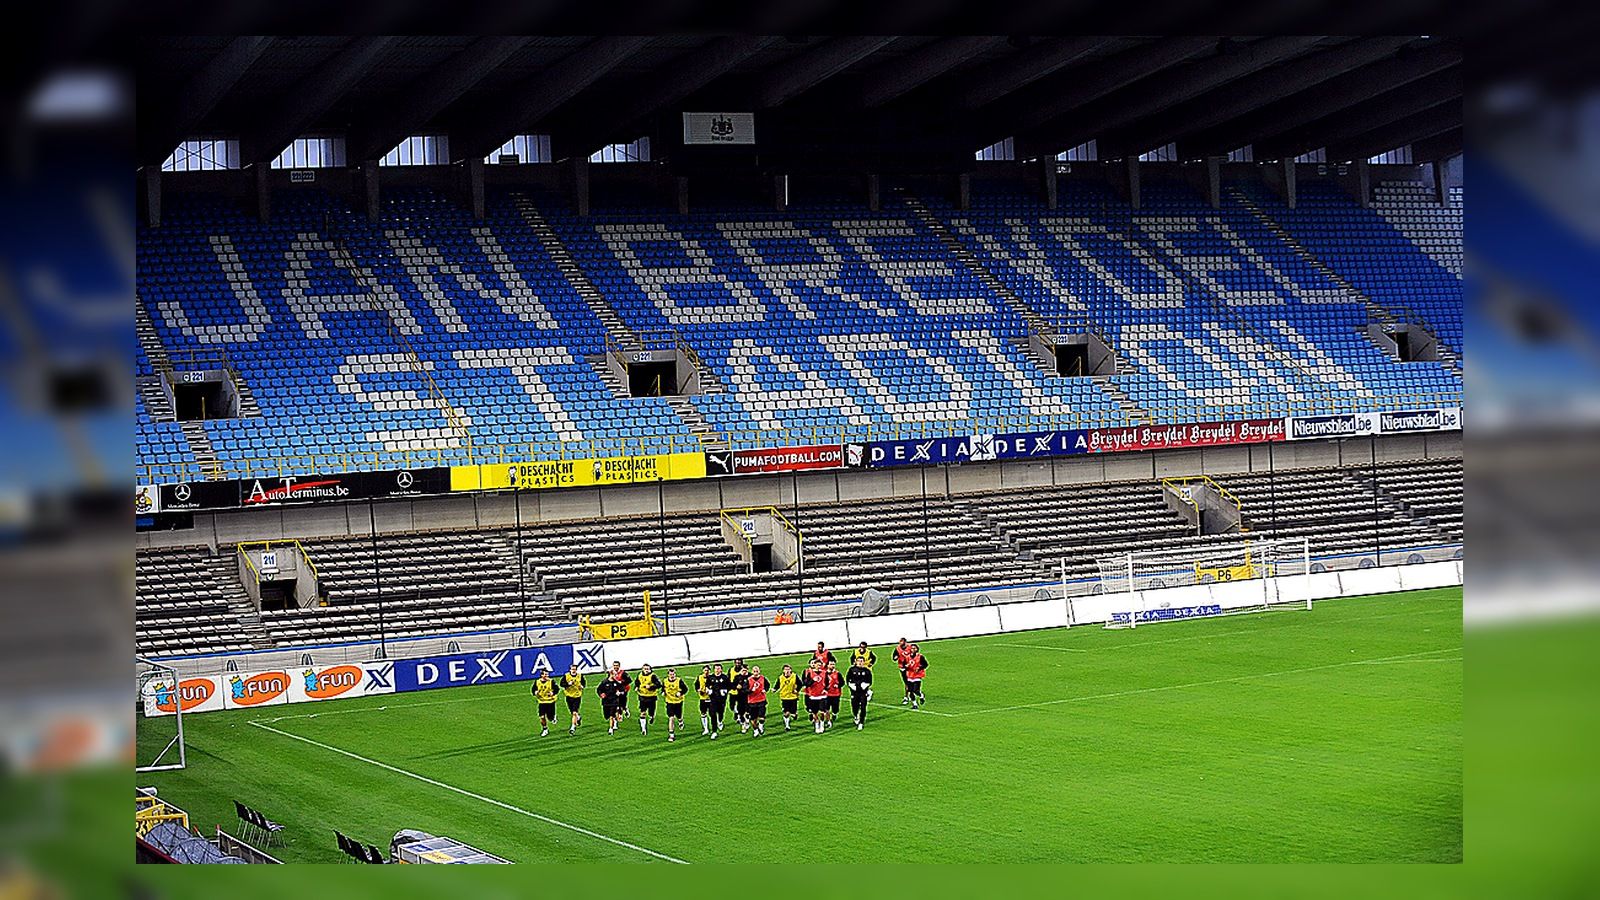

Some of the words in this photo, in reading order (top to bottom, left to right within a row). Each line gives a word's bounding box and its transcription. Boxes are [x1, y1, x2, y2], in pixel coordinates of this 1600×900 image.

[157, 227, 560, 343] JAN
[1293, 415, 1372, 436] Nieuwsblad.be
[1381, 410, 1457, 430] Nieuwsblad.be
[1090, 429, 1138, 449] Breydel
[1141, 425, 1187, 446] Breydel
[1190, 423, 1235, 443] Breydel
[1240, 420, 1285, 439] Breydel
[871, 440, 969, 462] DEXIA
[994, 432, 1088, 455] DEXIA
[605, 458, 656, 472] DESCHACHT
[734, 450, 841, 467] PUMAFOOTBALL.COM
[520, 462, 574, 477] DESCHACHT
[605, 470, 658, 481] PLASTICS
[521, 474, 574, 486] PLASTCS
[1217, 569, 1231, 581] P6
[1121, 610, 1160, 621] DXIA
[611, 624, 627, 638] P5
[416, 650, 554, 686] DEXIA
